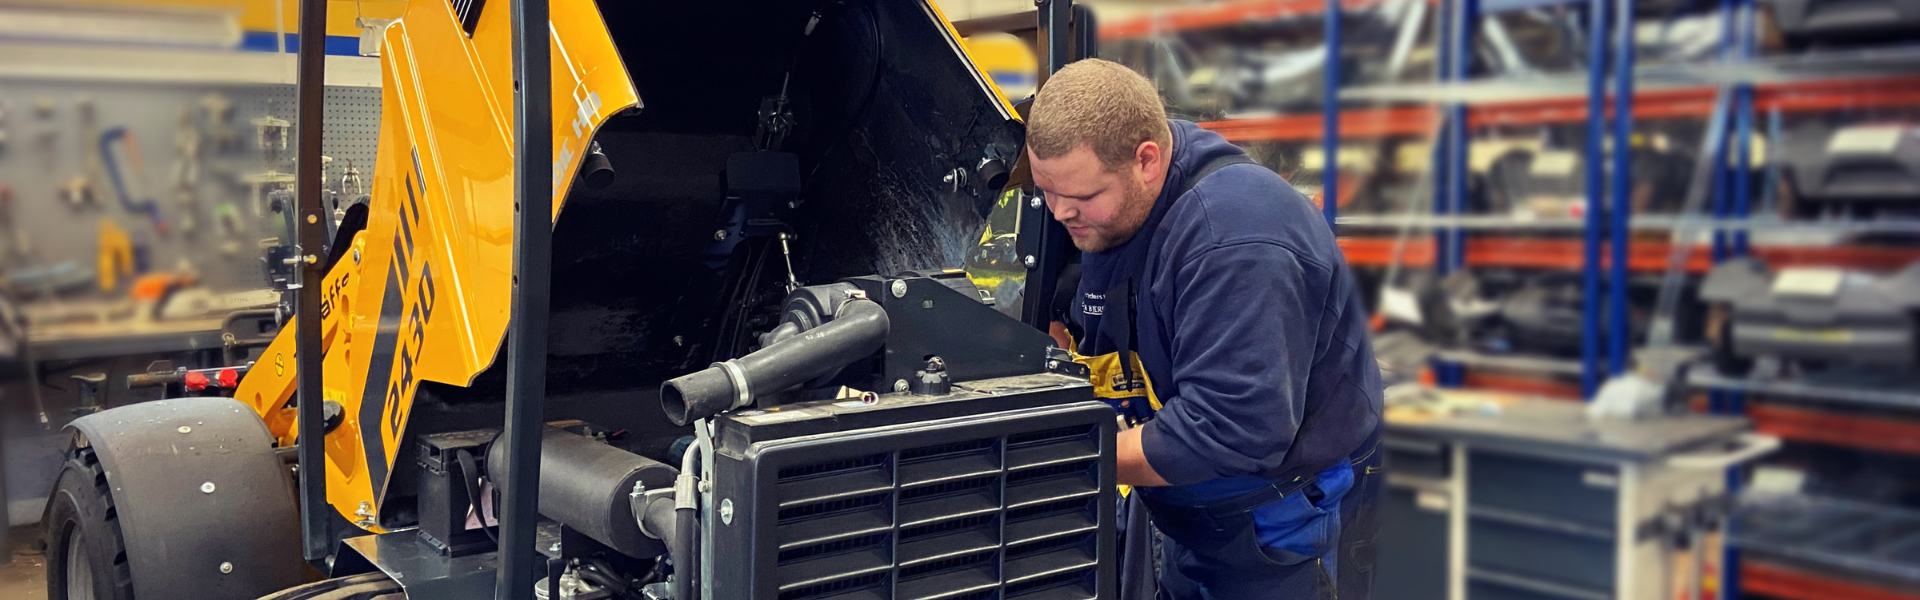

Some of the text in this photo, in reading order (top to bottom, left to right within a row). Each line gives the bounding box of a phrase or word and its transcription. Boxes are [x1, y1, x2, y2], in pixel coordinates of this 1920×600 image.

[553, 136, 575, 195] DIC
[321, 272, 350, 321] äffe
[1084, 292, 1103, 300] nders
[388, 260, 436, 442] 2430
